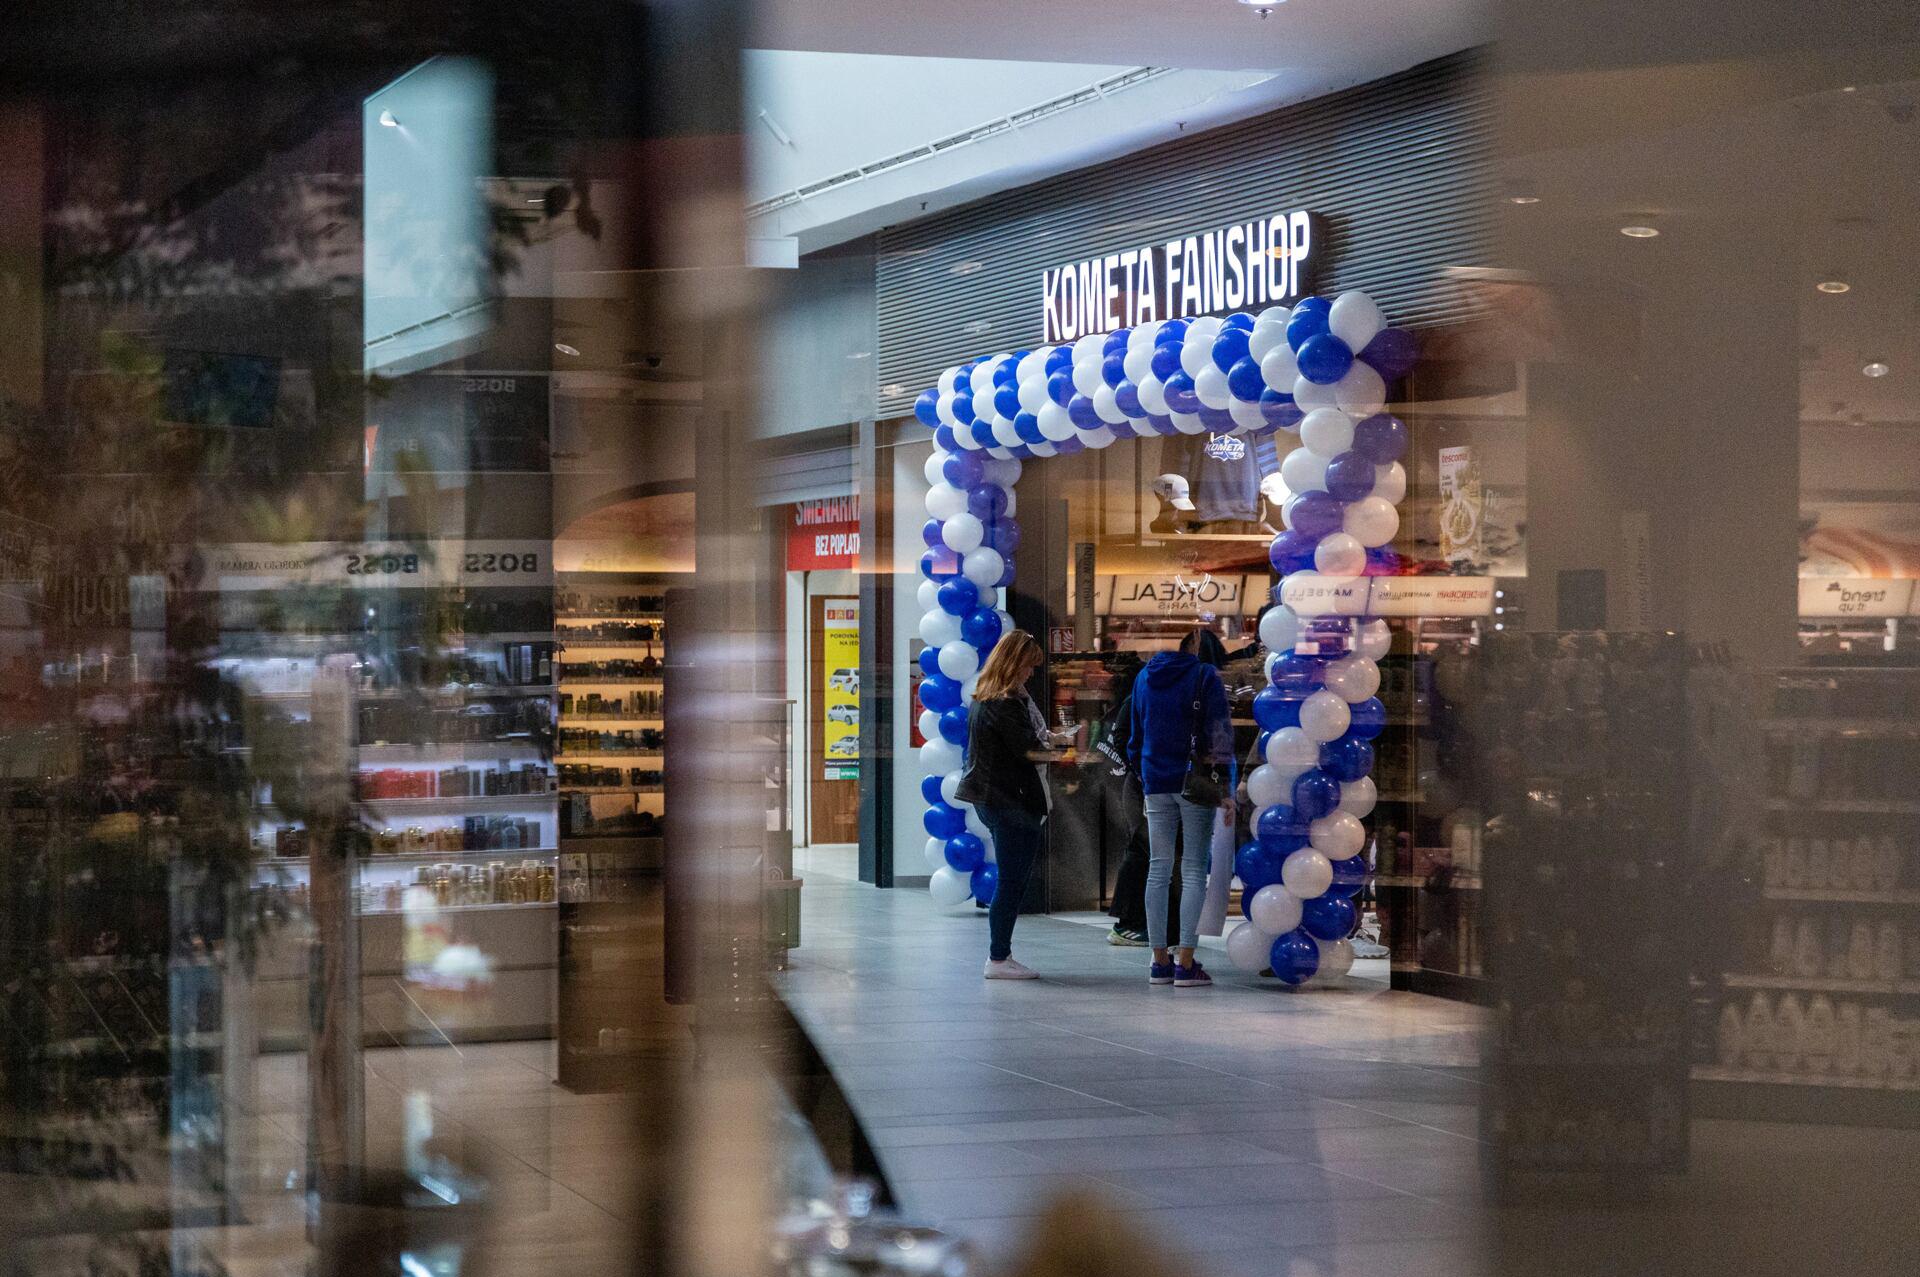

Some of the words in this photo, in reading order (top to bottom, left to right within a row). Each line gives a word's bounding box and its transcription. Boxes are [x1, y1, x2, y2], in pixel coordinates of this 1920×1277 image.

[1043, 247, 1156, 342] KOMETA
[1166, 211, 1310, 319] FANSHOP
[1204, 441, 1245, 451] KOMETA
[815, 535, 829, 556] BEZ
